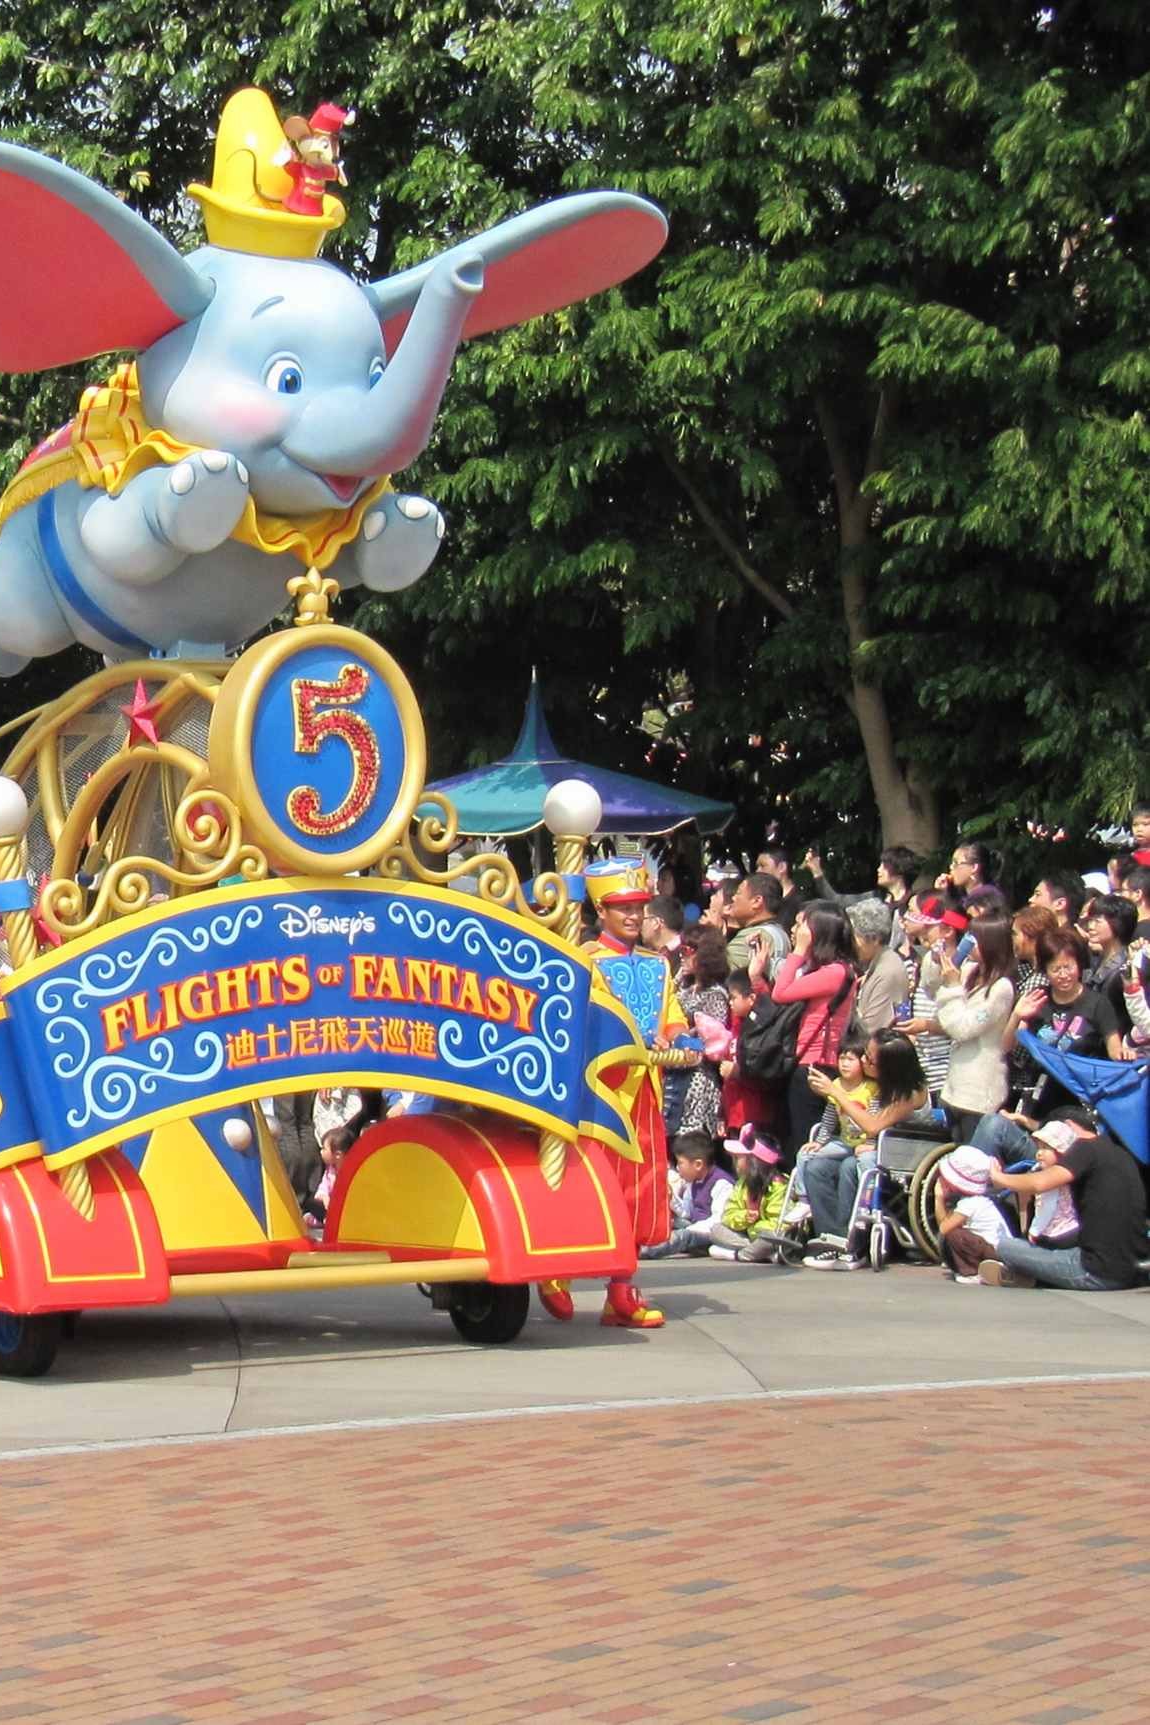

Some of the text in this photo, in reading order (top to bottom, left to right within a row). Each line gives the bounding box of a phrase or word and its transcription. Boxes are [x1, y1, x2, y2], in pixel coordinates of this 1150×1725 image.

[286, 663, 380, 835] 5
[273, 903, 376, 945] Disney's
[101, 953, 538, 1052] FLIGHTS OF FANTASY
[225, 1016, 438, 1070] 迪士尼飛天巡遊
